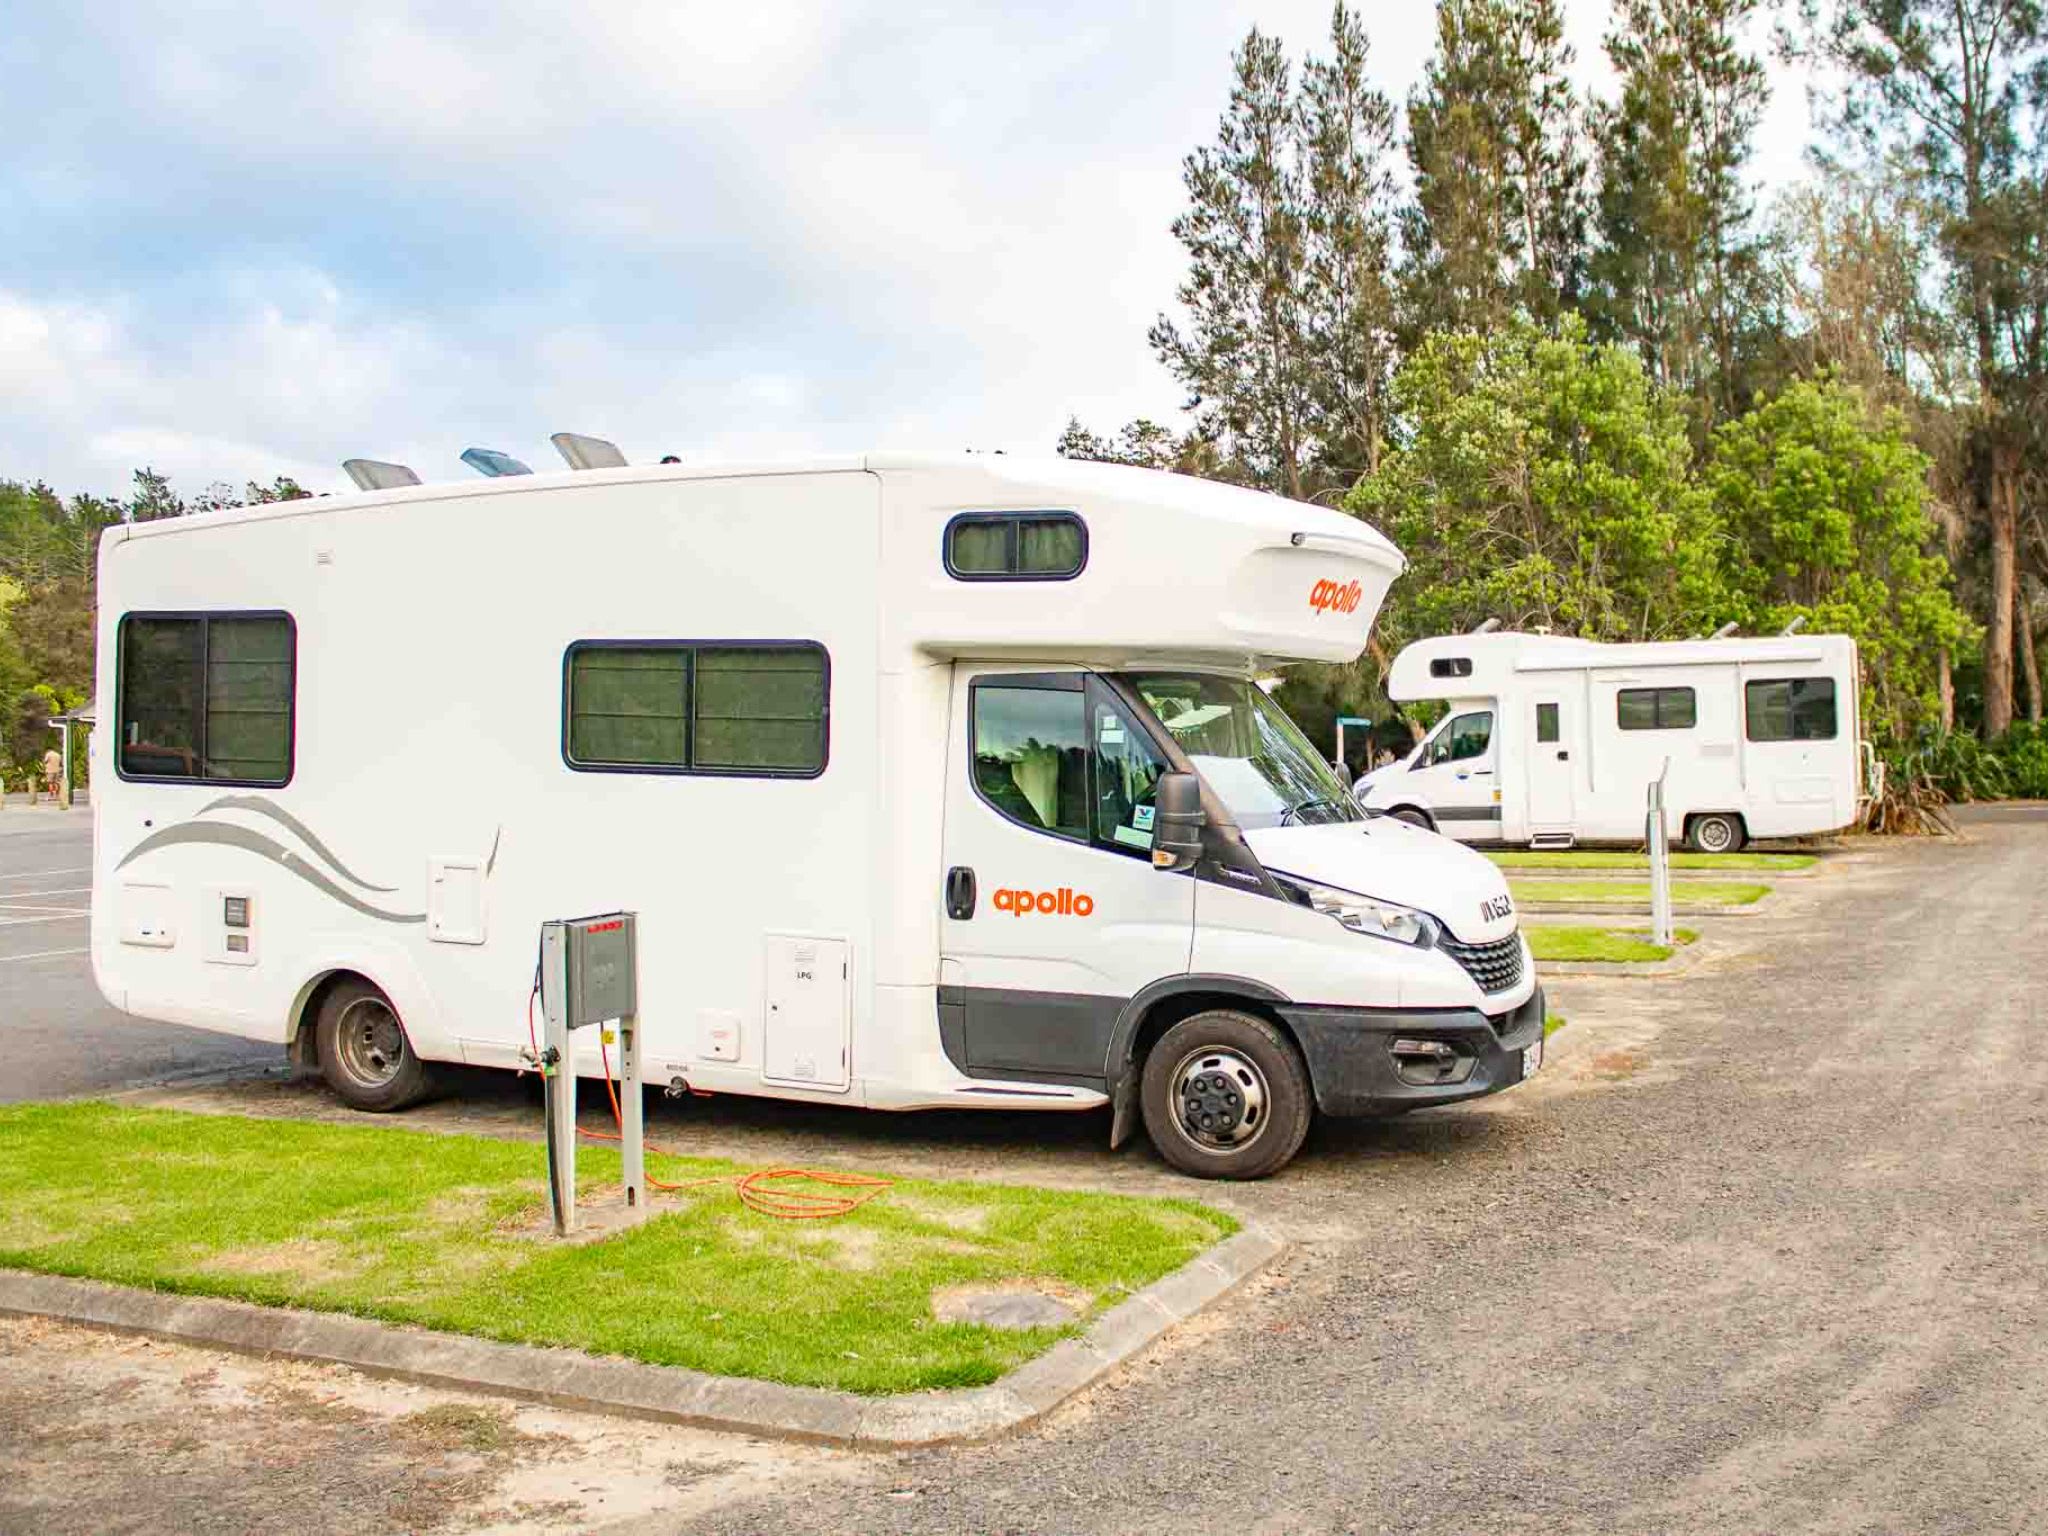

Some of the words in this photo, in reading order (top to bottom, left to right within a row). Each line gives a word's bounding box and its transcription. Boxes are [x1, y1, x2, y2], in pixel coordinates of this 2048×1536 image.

[1309, 578, 1362, 615] apollo
[993, 888, 1093, 917] apollo
[797, 971, 812, 980] LPG
